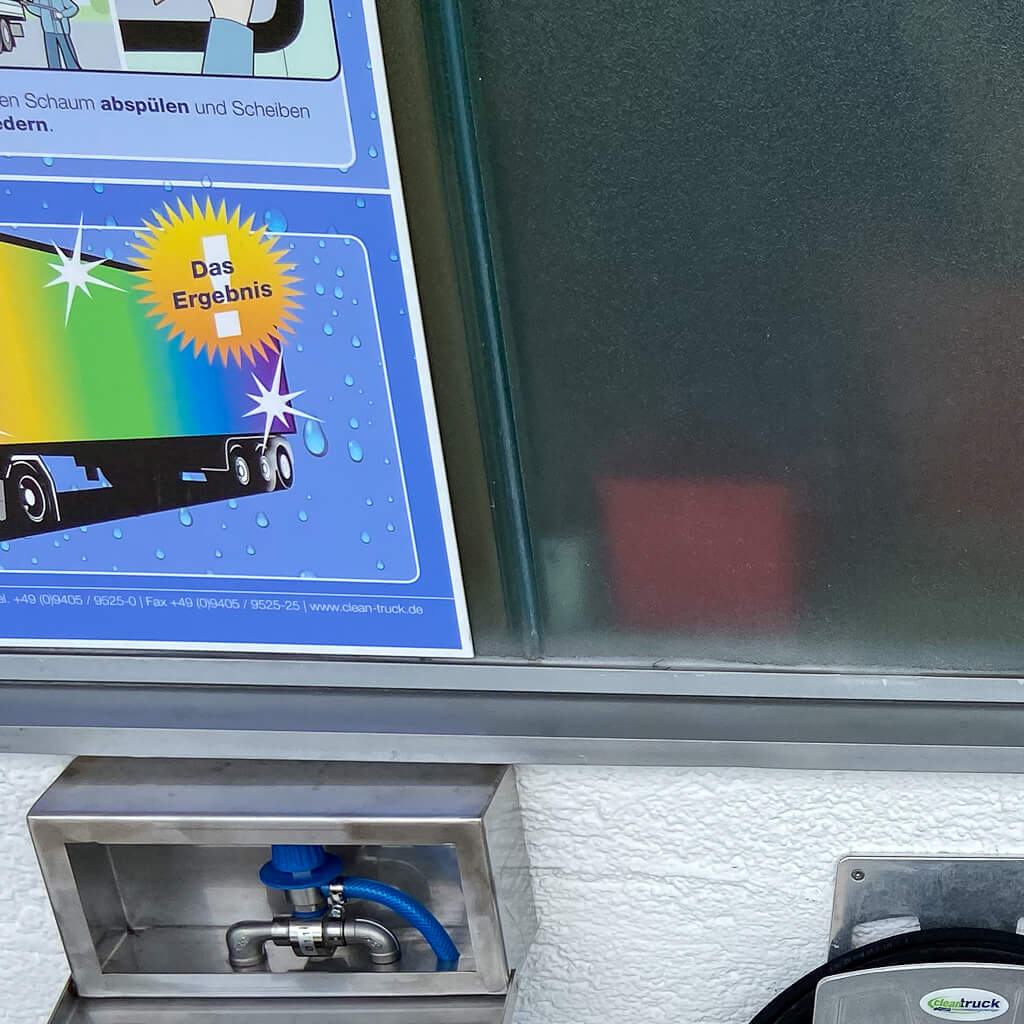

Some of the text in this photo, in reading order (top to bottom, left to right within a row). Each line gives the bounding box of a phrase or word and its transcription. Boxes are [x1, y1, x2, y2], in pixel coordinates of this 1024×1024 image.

[24, 92, 95, 111] Schaum
[100, 96, 190, 116] abspülen
[195, 100, 228, 115] und
[232, 100, 311, 119] Scheiben
[0, 115, 54, 132] dern.
[191, 260, 234, 279] Das
[172, 281, 273, 310] Ergebnis
[13, 593, 37, 605] +49
[39, 593, 83, 607] (0)9405
[93, 595, 137, 607] 9525-0
[145, 596, 168, 607] Fax
[171, 597, 193, 608] +49
[196, 597, 240, 609] (0)9405
[251, 599, 300, 611] 9525-25
[310, 601, 424, 615] www.clean-truck.de
